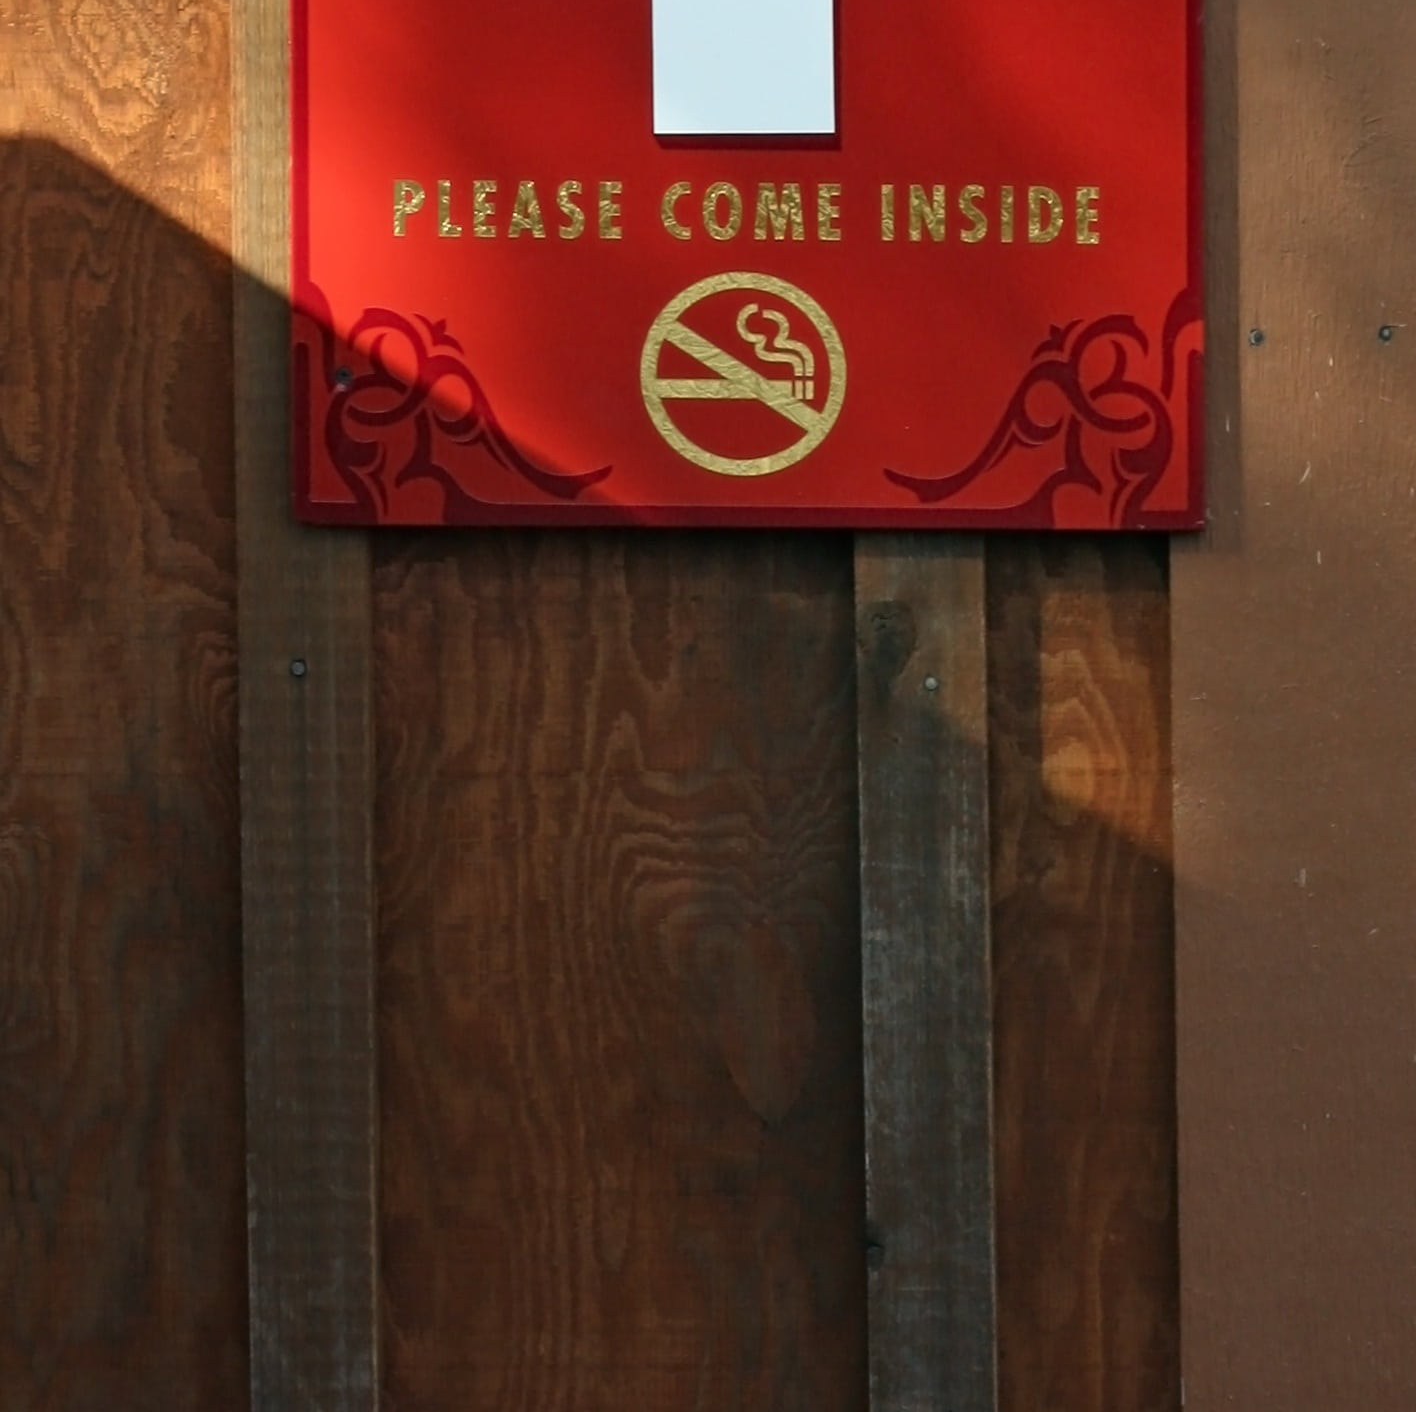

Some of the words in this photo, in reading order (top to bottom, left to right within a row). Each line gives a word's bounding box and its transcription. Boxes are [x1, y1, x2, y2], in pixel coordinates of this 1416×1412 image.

[391, 179, 624, 241] PLEASE
[659, 181, 843, 243] COME
[880, 183, 1101, 245] INSIDE
